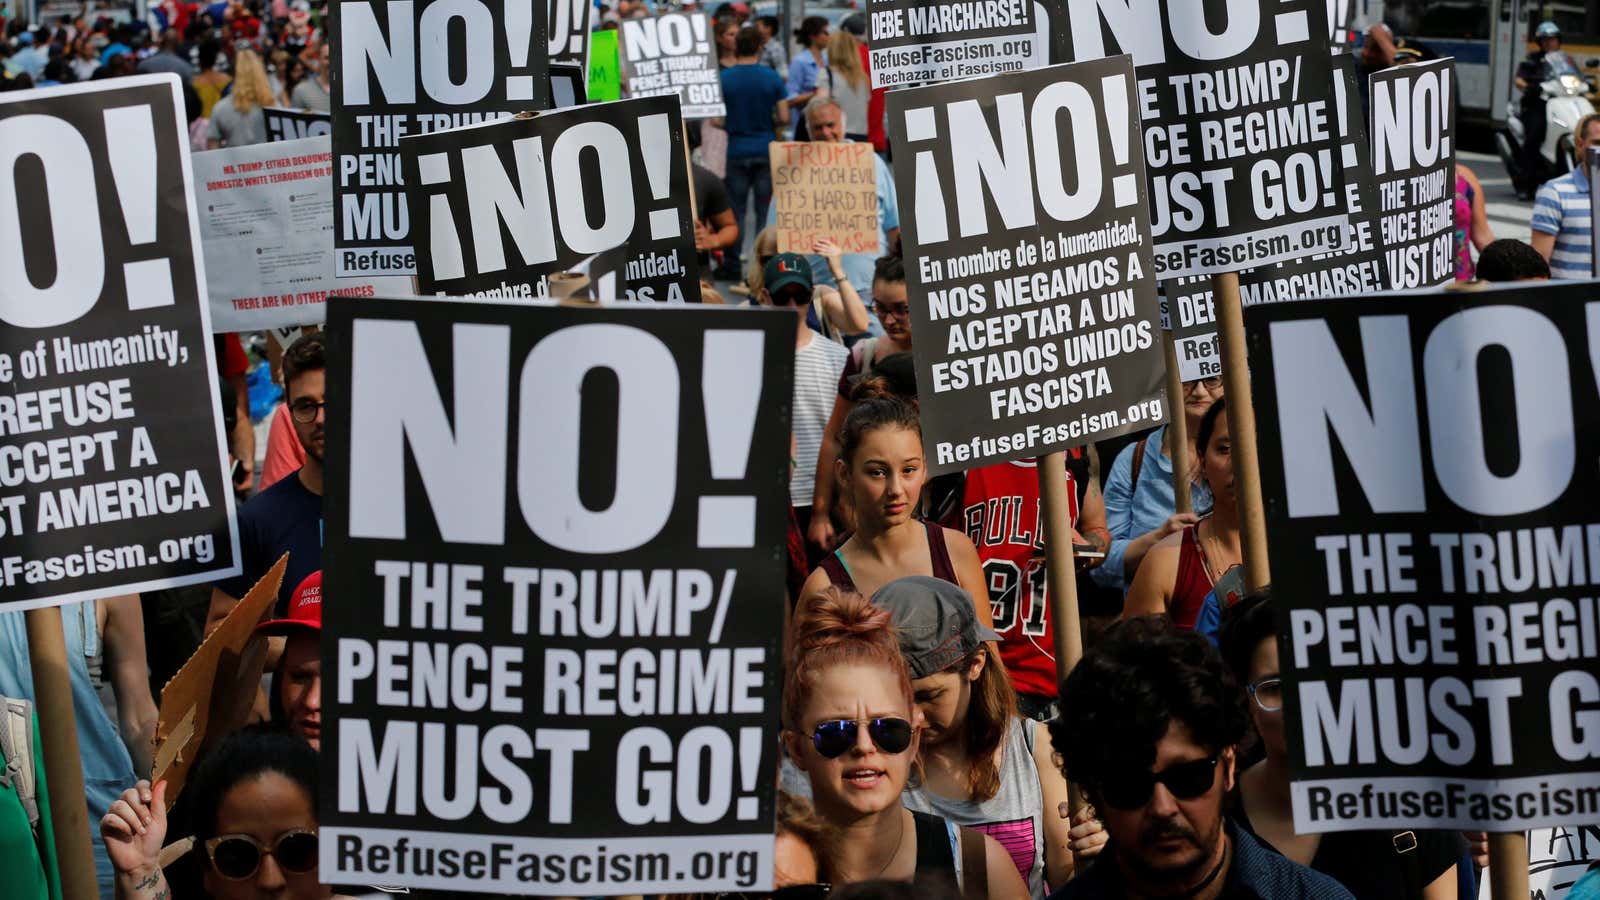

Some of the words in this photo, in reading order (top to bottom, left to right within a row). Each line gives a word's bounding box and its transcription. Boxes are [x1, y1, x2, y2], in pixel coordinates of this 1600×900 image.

[623, 13, 710, 62] NO!
[871, 9, 905, 41] DEBE
[908, 0, 1029, 36] MARCHARSE!
[341, 0, 534, 105] NO!
[629, 73, 671, 91] PENCE
[670, 69, 719, 86] REGIME
[634, 61, 660, 76] THE
[660, 55, 708, 71] TRUMP/
[872, 39, 1032, 71] RefuseFascism.org
[879, 69, 937, 86] Rechazar
[943, 65, 955, 78] el
[957, 60, 1023, 78] Fascismo
[688, 84, 721, 105] GO!
[1169, 55, 1302, 117] TRUMP/
[356, 114, 408, 148] THE
[1200, 101, 1329, 162] REGIME
[1374, 68, 1451, 175] NO!
[207, 179, 244, 192] DOMESTIC
[244, 175, 269, 187] WHITE
[269, 169, 313, 184] TERRORISM
[313, 167, 325, 178] OR
[266, 157, 292, 170] EITHER
[776, 167, 800, 185] SO
[810, 168, 846, 185] MUCH
[849, 167, 875, 185] EVIL
[780, 143, 868, 167] TRUMP
[904, 73, 1138, 246] ¡NO!
[418, 113, 682, 281] ¡NO!
[779, 190, 807, 210] IT'S
[812, 191, 857, 211] HARD
[862, 190, 877, 211] TO
[1250, 149, 1337, 221] GO!
[1380, 182, 1406, 212] THE
[1410, 168, 1448, 205] TRUMP/
[776, 212, 823, 230] DECIDE
[826, 213, 863, 231] WHAT
[863, 215, 878, 230] TO
[1420, 199, 1453, 238] REGIME
[919, 255, 943, 284] En
[947, 246, 1012, 280] nombre
[1016, 239, 1037, 268] de
[1040, 236, 1056, 262] la
[1059, 216, 1143, 257] humanidad,
[1432, 232, 1453, 281] GO!
[231, 297, 261, 312] THERE
[262, 294, 280, 310] ARE
[281, 293, 295, 307] NO
[296, 290, 328, 306] OTHER
[330, 285, 375, 298] CHOICES
[927, 283, 987, 321] NOS
[993, 256, 1120, 310] NEGAMOS
[1126, 252, 1144, 281] A
[947, 303, 1073, 355] ACEPTAR
[1079, 298, 1096, 329] A
[1101, 288, 1136, 322] UN
[20, 340, 48, 379] of
[53, 325, 189, 374] Humanity,
[931, 342, 1059, 393] ESTADOS
[1064, 319, 1153, 367] UNIDOS
[990, 366, 1112, 420] FASCISTA
[0, 430, 118, 488] CCEPT
[130, 426, 158, 468] A
[348, 317, 766, 555] NO!
[936, 399, 1164, 466] RefuseFascism.org
[37, 469, 210, 533] AMERICA
[0, 533, 216, 588] Fascism.org
[1315, 532, 1418, 596] THE
[374, 559, 484, 633] THE
[502, 568, 738, 644] TRUMP/
[1290, 604, 1459, 669] PENCE
[337, 637, 524, 714] PENCE
[543, 646, 766, 717] REGIME
[1298, 676, 1523, 768] MUST
[337, 717, 591, 825] MUST
[614, 725, 764, 826] GO!
[336, 833, 760, 888] RefuseFascism.org
